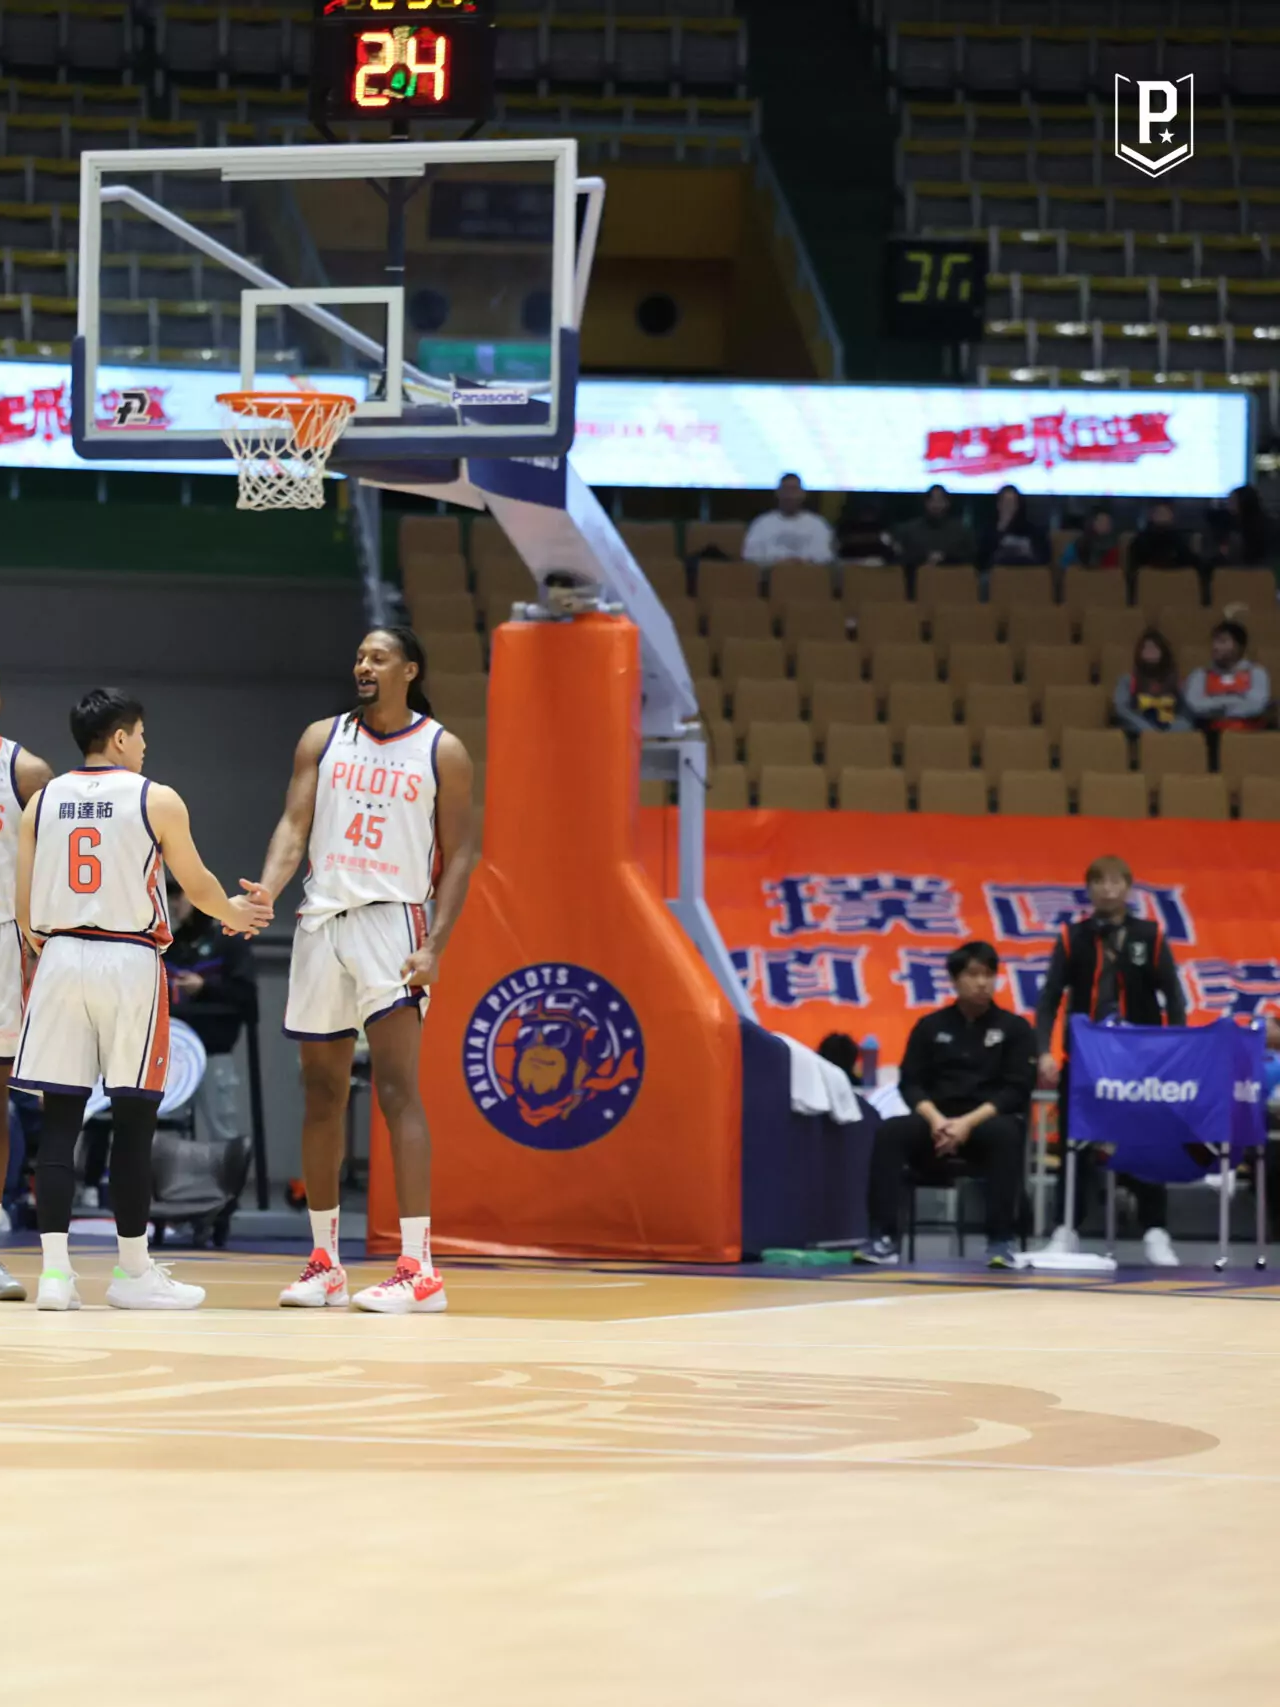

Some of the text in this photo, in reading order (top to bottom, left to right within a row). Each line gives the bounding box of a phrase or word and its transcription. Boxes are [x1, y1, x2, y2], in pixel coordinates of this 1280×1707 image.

[354, 32, 447, 107] 24
[451, 391, 526, 405] Panasonic
[332, 761, 423, 803] PILOTS
[344, 812, 388, 850] 45
[68, 827, 101, 893] 6
[467, 967, 570, 1111] PAUIAN PILOTS
[1095, 1077, 1199, 1103] molten
